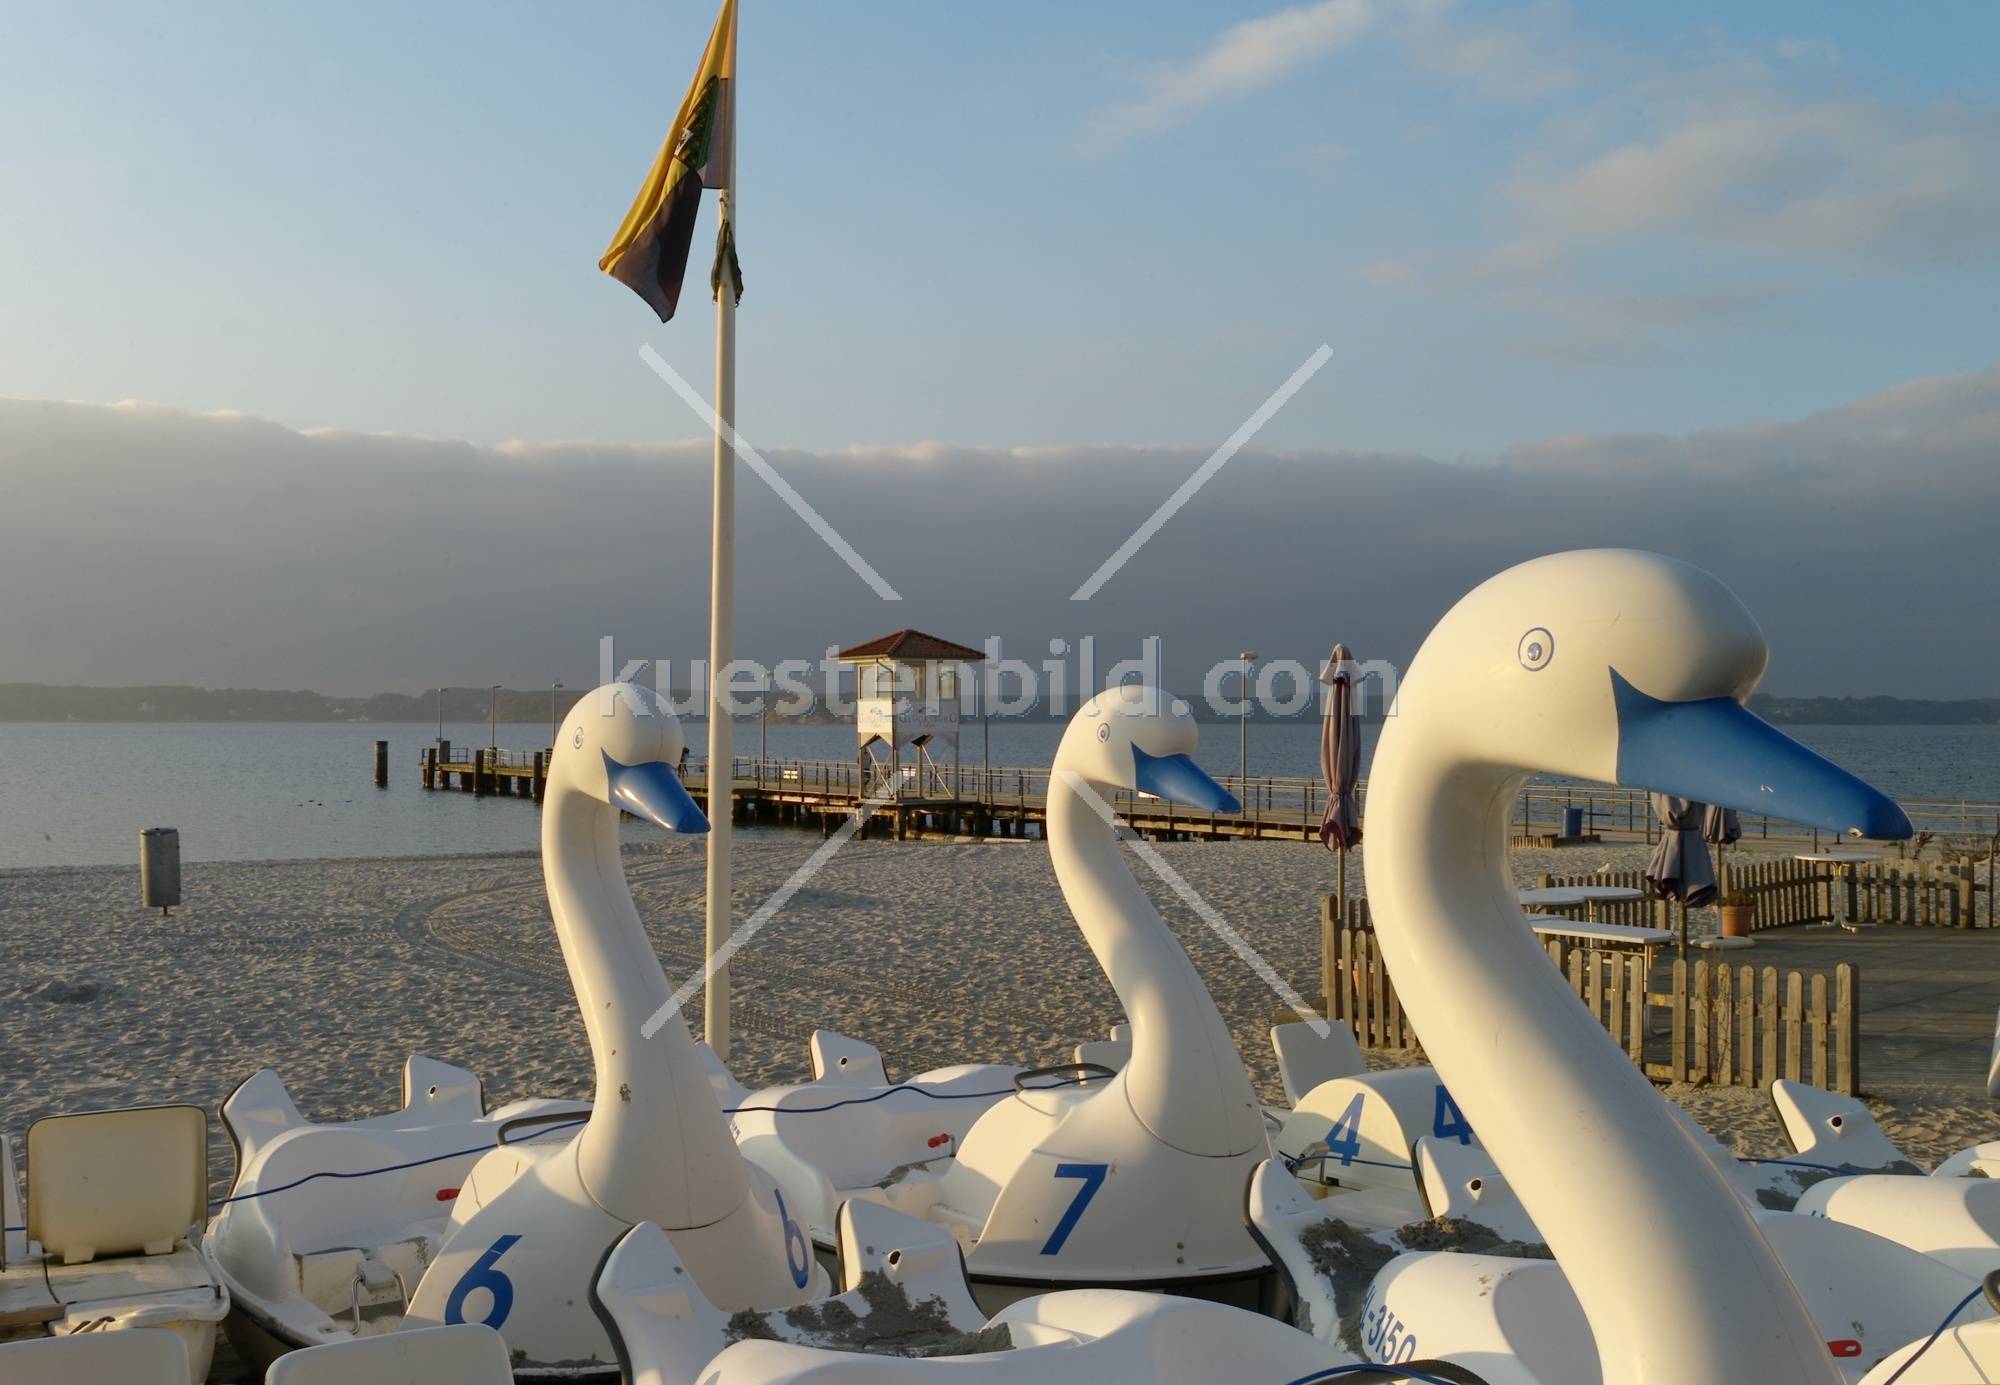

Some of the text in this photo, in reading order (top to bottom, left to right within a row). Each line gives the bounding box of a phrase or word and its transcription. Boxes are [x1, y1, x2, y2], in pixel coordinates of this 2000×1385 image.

[1325, 1093, 1365, 1166] 4
[1433, 1085, 1473, 1145] 4
[774, 1188, 809, 1289] 6
[1040, 1164, 1108, 1255] 7
[445, 1234, 523, 1330] 6
